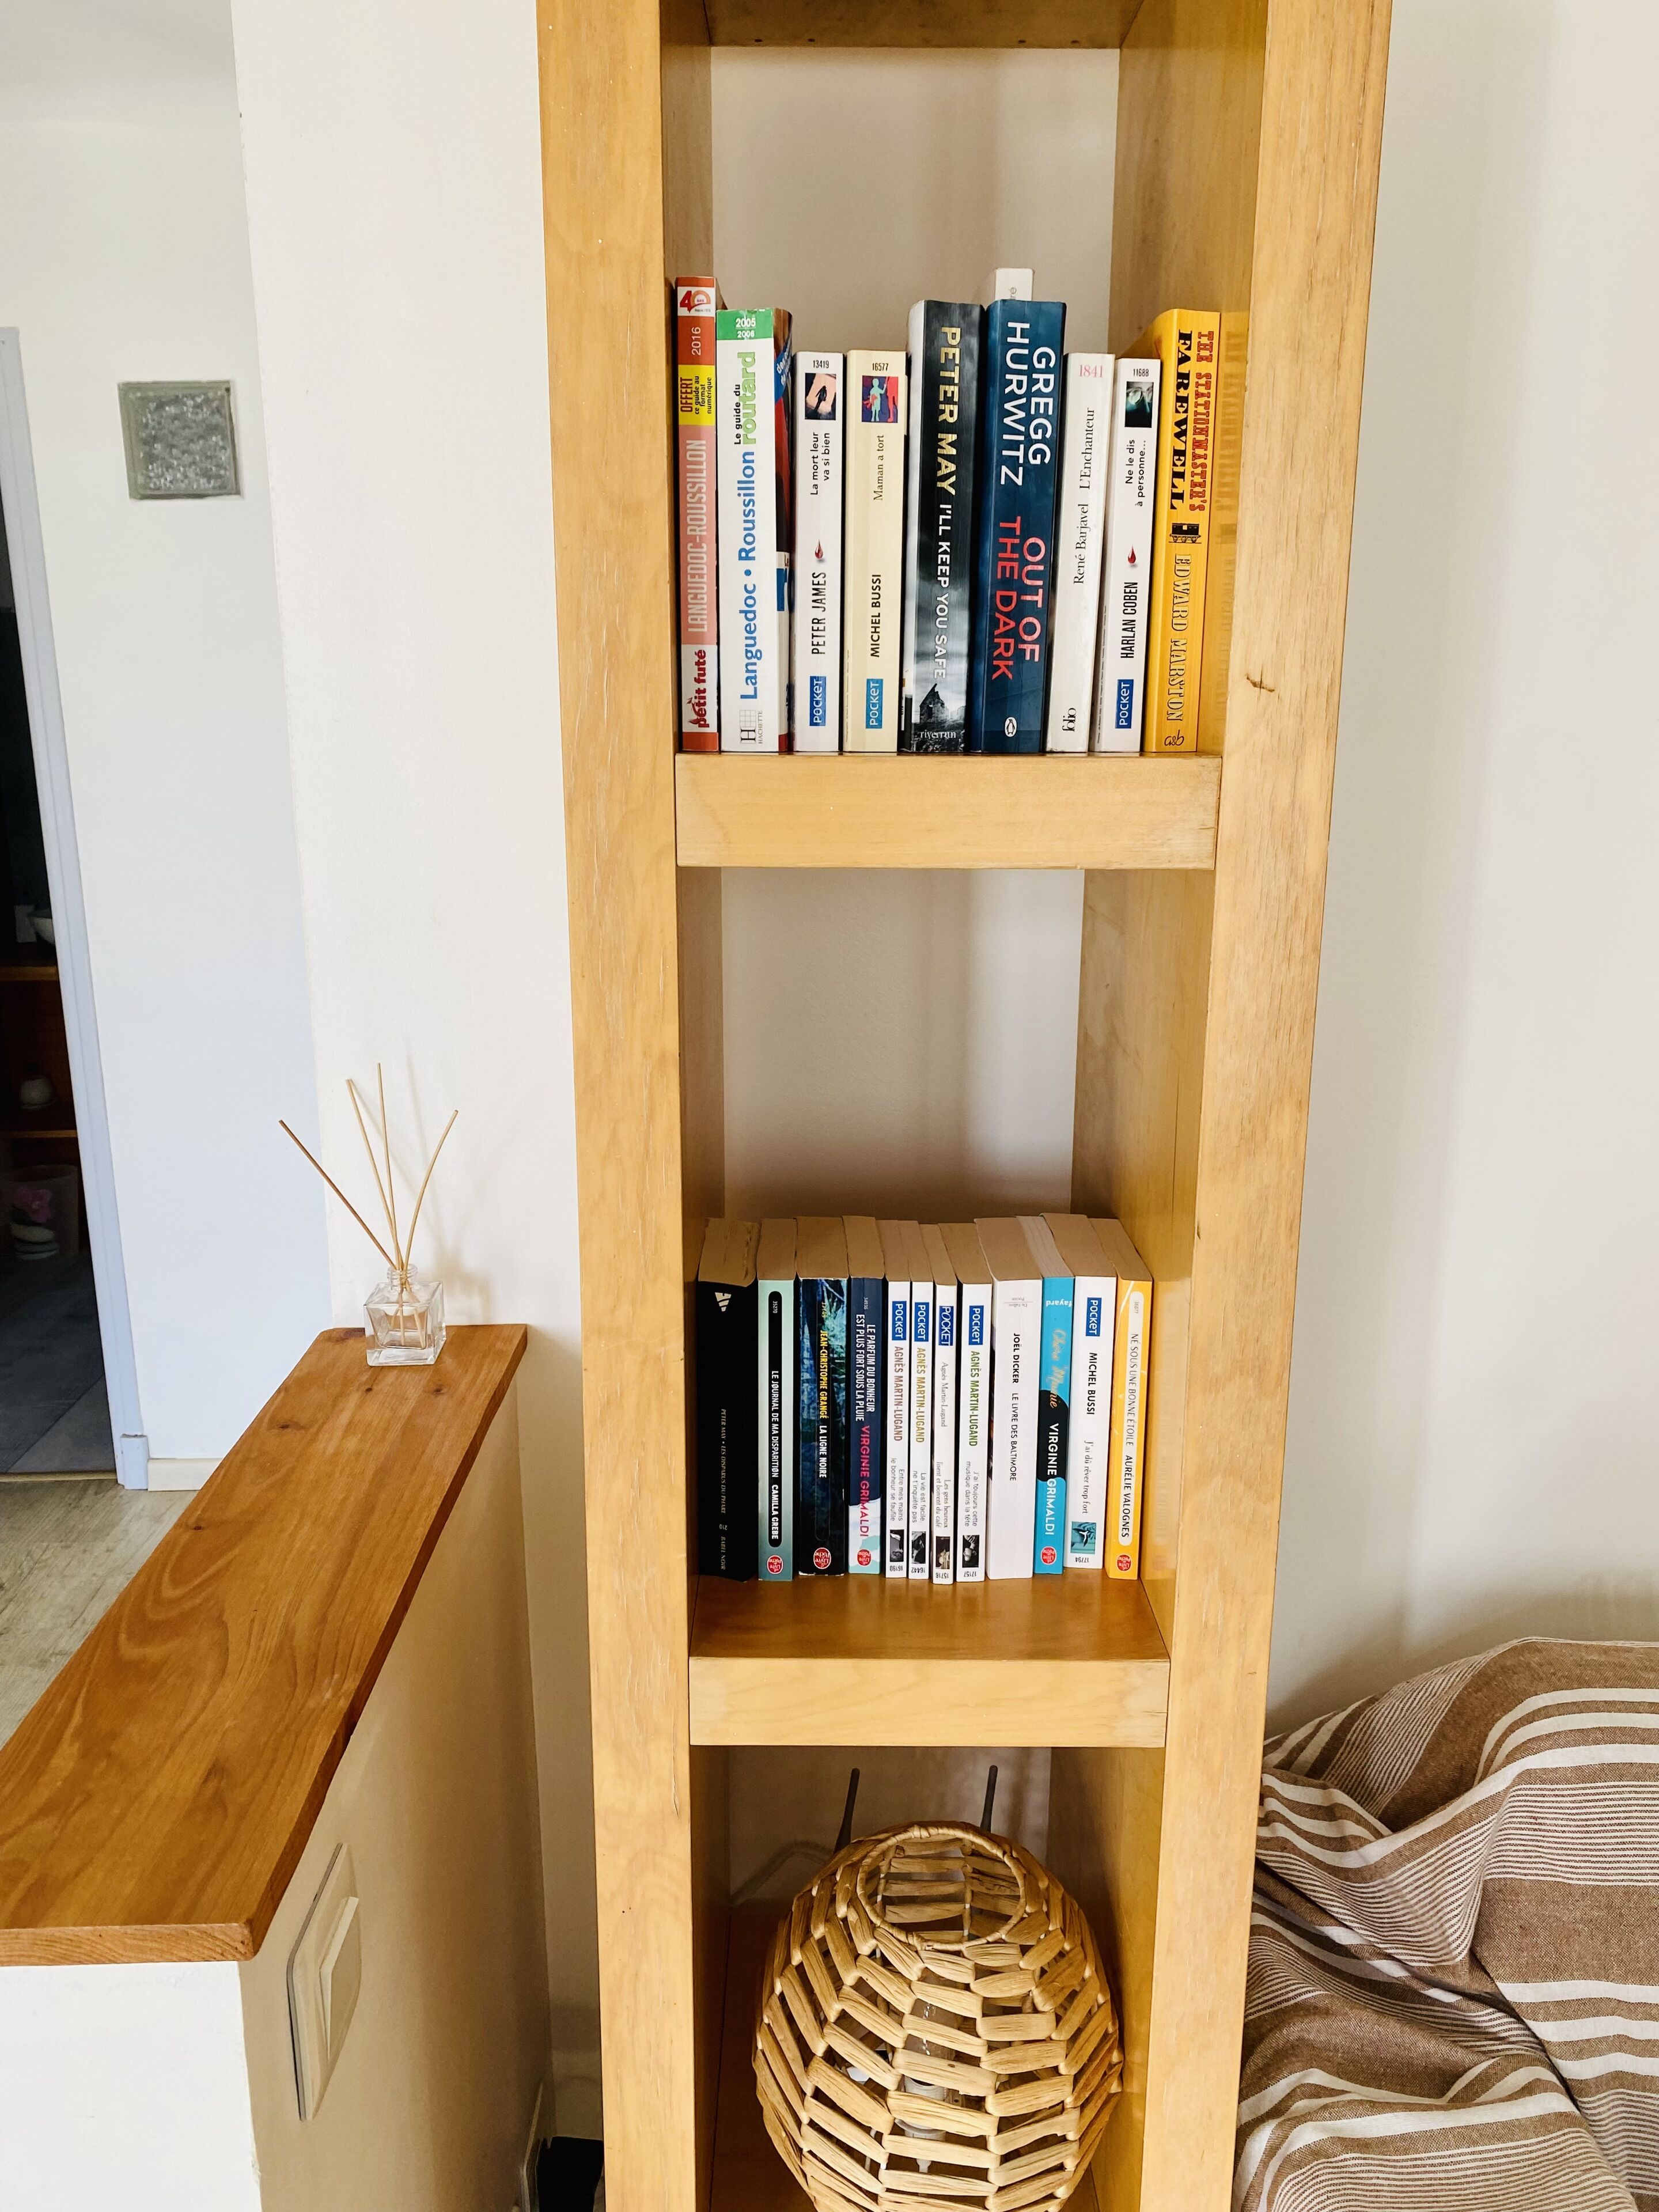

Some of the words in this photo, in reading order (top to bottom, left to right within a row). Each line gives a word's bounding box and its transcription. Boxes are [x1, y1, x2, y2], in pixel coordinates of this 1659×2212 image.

[736, 318, 756, 328] 2005
[737, 330, 755, 338] 2006
[691, 327, 701, 355] 2016
[1196, 331, 1214, 363] THE
[813, 360, 829, 369] 13419
[872, 363, 889, 371] 16577
[938, 326, 961, 423] PETER
[1078, 364, 1104, 378] 1841
[1133, 368, 1149, 377] 11688
[695, 376, 699, 384] au
[733, 384, 740, 396] du
[680, 377, 693, 412] OFFERT
[737, 351, 756, 445] routard
[1000, 321, 1030, 486] HURWITZ
[1028, 347, 1056, 465] GREGG
[733, 402, 742, 430] guide
[1170, 329, 1192, 510] FAREWELL
[734, 433, 741, 445] Le
[810, 432, 819, 452] leur
[821, 433, 830, 456] bien
[1079, 407, 1094, 490] L'Enchanteur
[1126, 440, 1135, 454] dis
[1190, 372, 1211, 512] STATIONMASTER'S
[823, 469, 830, 481] va
[936, 433, 957, 496] MAY
[1125, 457, 1134, 466] le
[1137, 440, 1146, 498] personne...
[810, 484, 818, 495] La
[873, 464, 884, 501] Maman
[1125, 470, 1133, 484] Ne
[737, 451, 756, 561] Roussillon
[938, 504, 952, 536] I'LL
[686, 440, 707, 632] LANGUEDOC-ROUSSILLON
[1075, 503, 1091, 550] Barjavel
[997, 516, 1021, 579] THE
[937, 541, 951, 588] KEEP
[1020, 536, 1046, 608] OUT
[1073, 554, 1085, 585] René
[812, 572, 826, 612] JAMES
[871, 574, 881, 608] BUSSI
[1123, 582, 1138, 615] COBEN
[1171, 553, 1192, 632] EDWARD
[935, 593, 949, 629] YOU
[738, 583, 762, 699] Languedoc
[811, 617, 826, 654] PETER
[870, 612, 881, 658] MICHEL
[991, 589, 1017, 680] DARK
[1018, 616, 1041, 662] OF
[1120, 619, 1136, 658] HARLAN
[694, 649, 706, 684] futé
[934, 634, 948, 679] SAFE
[1166, 638, 1187, 722] MARSTON
[693, 687, 710, 728] petit
[1062, 707, 1077, 732] folio
[920, 729, 956, 740] riverrun
[1046, 1298, 1073, 1308] fayard
[855, 1314, 865, 1327] EST
[866, 1324, 876, 1334] LE
[941, 1306, 951, 1346] POCKET
[855, 1329, 865, 1348] PLUS
[866, 1334, 876, 1365] PARFUM
[1013, 1332, 1022, 1352] JOËL
[1131, 1334, 1141, 1344] NÉ
[820, 1330, 828, 1389] JEAN-CHRISTOPHE
[855, 1349, 865, 1368] FORT
[894, 1346, 905, 1373] AGNÈS
[916, 1347, 927, 1374] AGNÈS
[971, 1351, 982, 1378] AGNÈS
[1088, 1352, 1097, 1387] MICHEL
[1130, 1346, 1138, 1368] SOUS
[771, 1370, 779, 1379] LE
[855, 1369, 865, 1389] SOUS
[866, 1366, 876, 1377] DU
[941, 1362, 949, 1381] Agnès
[1128, 1370, 1138, 1387] UNE
[820, 1391, 829, 1419] GRANGÉ
[855, 1390, 865, 1399] LA
[866, 1378, 876, 1412] BONHEUR
[893, 1376, 903, 1441] MARTIN-LUGAND
[940, 1382, 949, 1427] Martin-Lugand
[1012, 1393, 1018, 1401] LE
[1086, 1389, 1096, 1415] BUSSI
[1127, 1389, 1137, 1417] BONNE
[771, 1412, 779, 1422] DE
[855, 1400, 865, 1422] PLUIE
[915, 1377, 926, 1443] MARTIN-LUGAND
[969, 1380, 979, 1446] MARTIN-LUGAND
[771, 1423, 779, 1434] MA
[819, 1425, 827, 1434] LA
[1126, 1419, 1137, 1446] ÉTOILE
[819, 1436, 827, 1455] LIGNE
[860, 1425, 870, 1478] VIRGINIE
[1047, 1423, 1059, 1475] VIRGINIE
[1084, 1440, 1093, 1452] J'ai
[1085, 1455, 1093, 1464] dû
[819, 1457, 827, 1478] NOIRE
[921, 1472, 926, 1480] La
[1124, 1455, 1134, 1490] AURÉLIE
[721, 1485, 726, 1494] DU
[890, 1493, 896, 1501] se
[1081, 1484, 1089, 1499] trop
[859, 1480, 870, 1537] GRIMALDI
[1045, 1478, 1057, 1535] GRIMALDI
[1082, 1501, 1090, 1514] fort
[1122, 1493, 1131, 1538] VALOGNES
